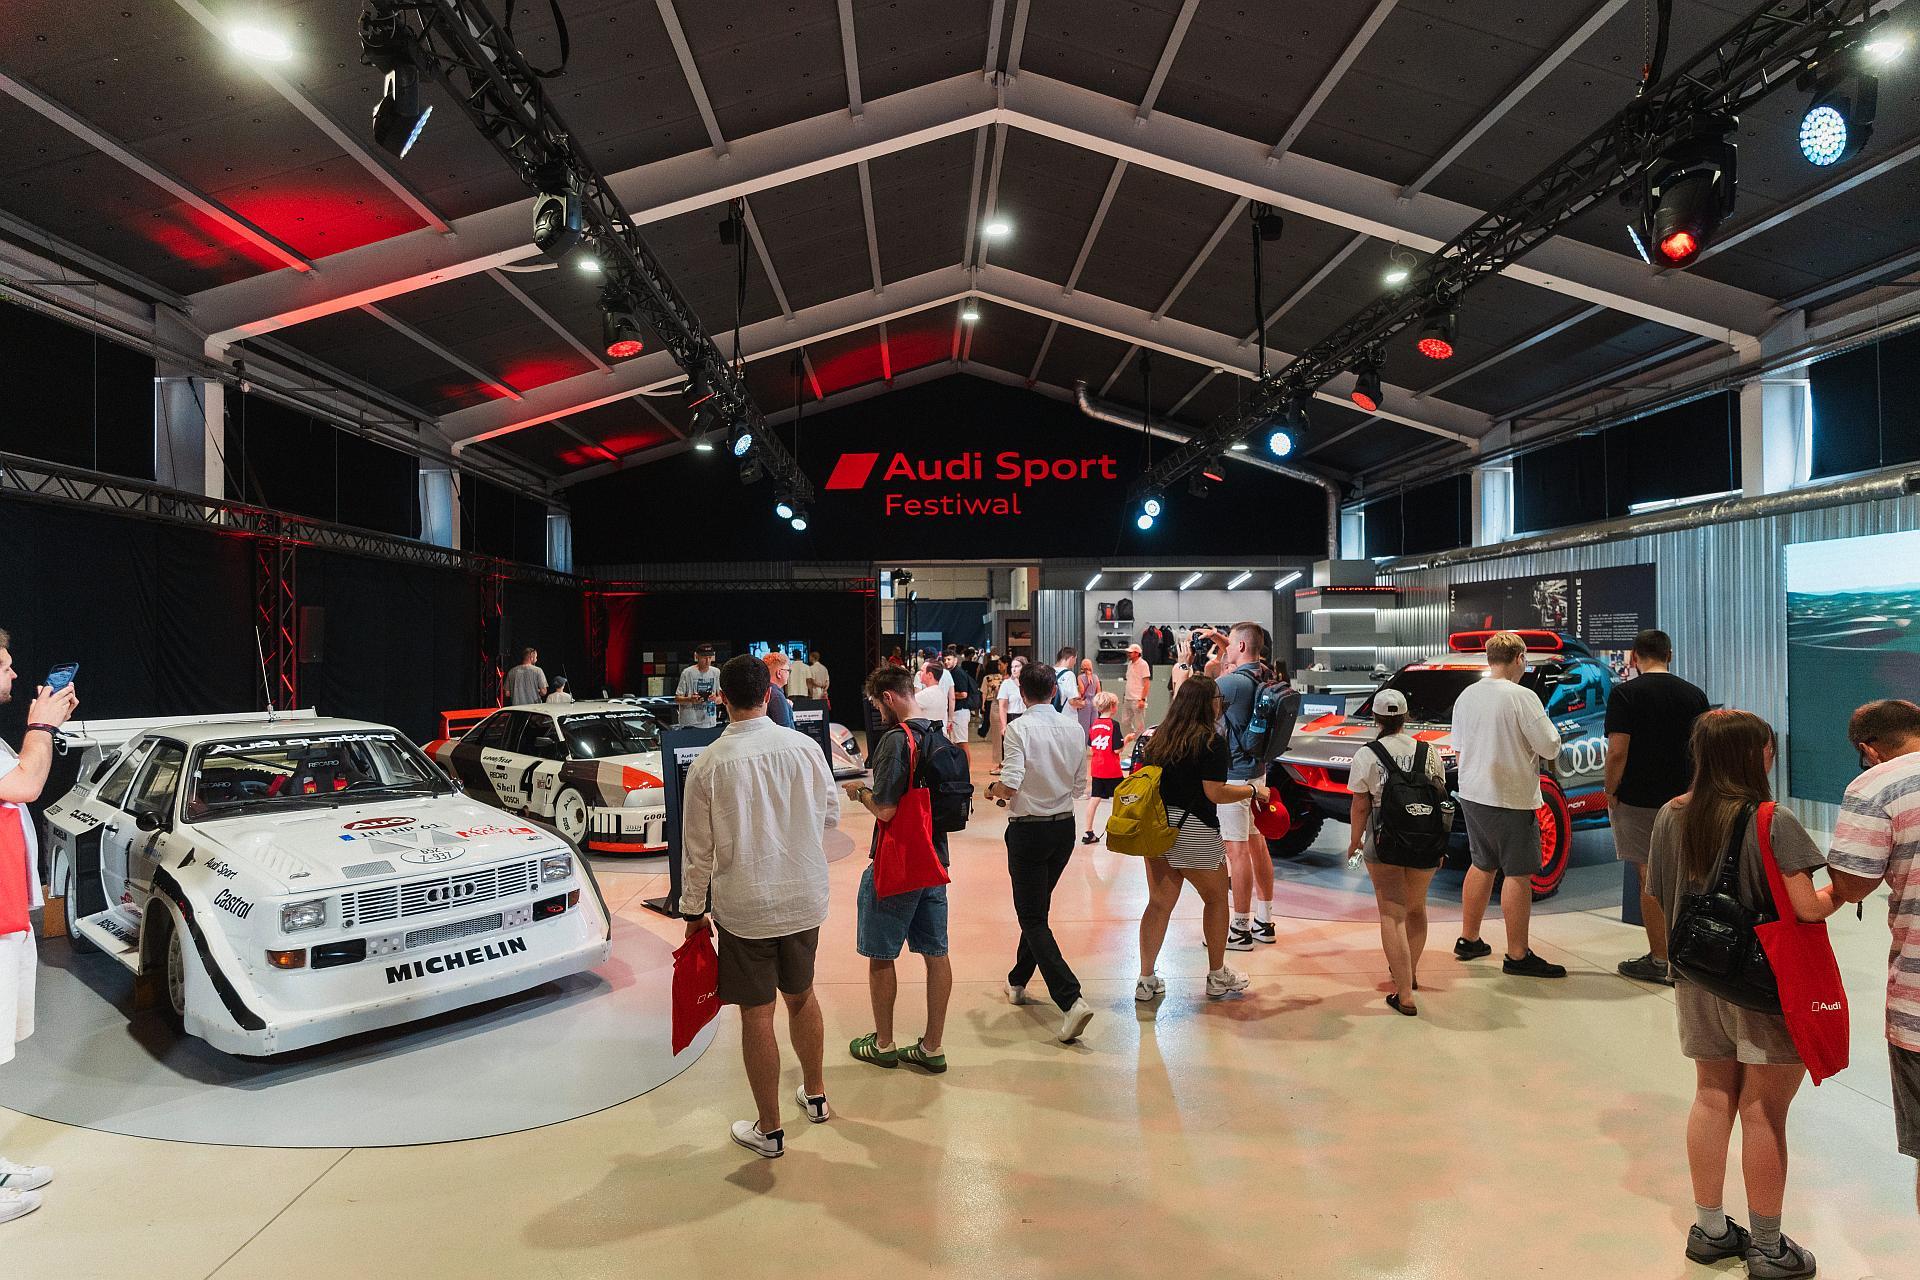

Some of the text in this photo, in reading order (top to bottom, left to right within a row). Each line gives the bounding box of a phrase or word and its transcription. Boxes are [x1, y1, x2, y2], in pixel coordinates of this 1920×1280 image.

[883, 451, 1117, 487] Audi Sport
[885, 493, 1022, 516] Festiwal
[1575, 577, 1582, 586] E
[563, 715, 599, 725] Audi
[210, 734, 397, 755] Audi quattro
[1091, 735, 1110, 750] 44
[308, 760, 340, 768] RECARO
[489, 771, 508, 780] RECARO
[519, 760, 543, 802] 4
[496, 782, 516, 793] Shell
[503, 795, 520, 804] BOSCH
[69, 809, 99, 826] quattro
[351, 817, 415, 830] Audi
[204, 857, 238, 880] Audi Sport
[214, 888, 254, 920] Castrol
[386, 936, 528, 984] MICHELIN
[1820, 1001, 1841, 1011] Audi
